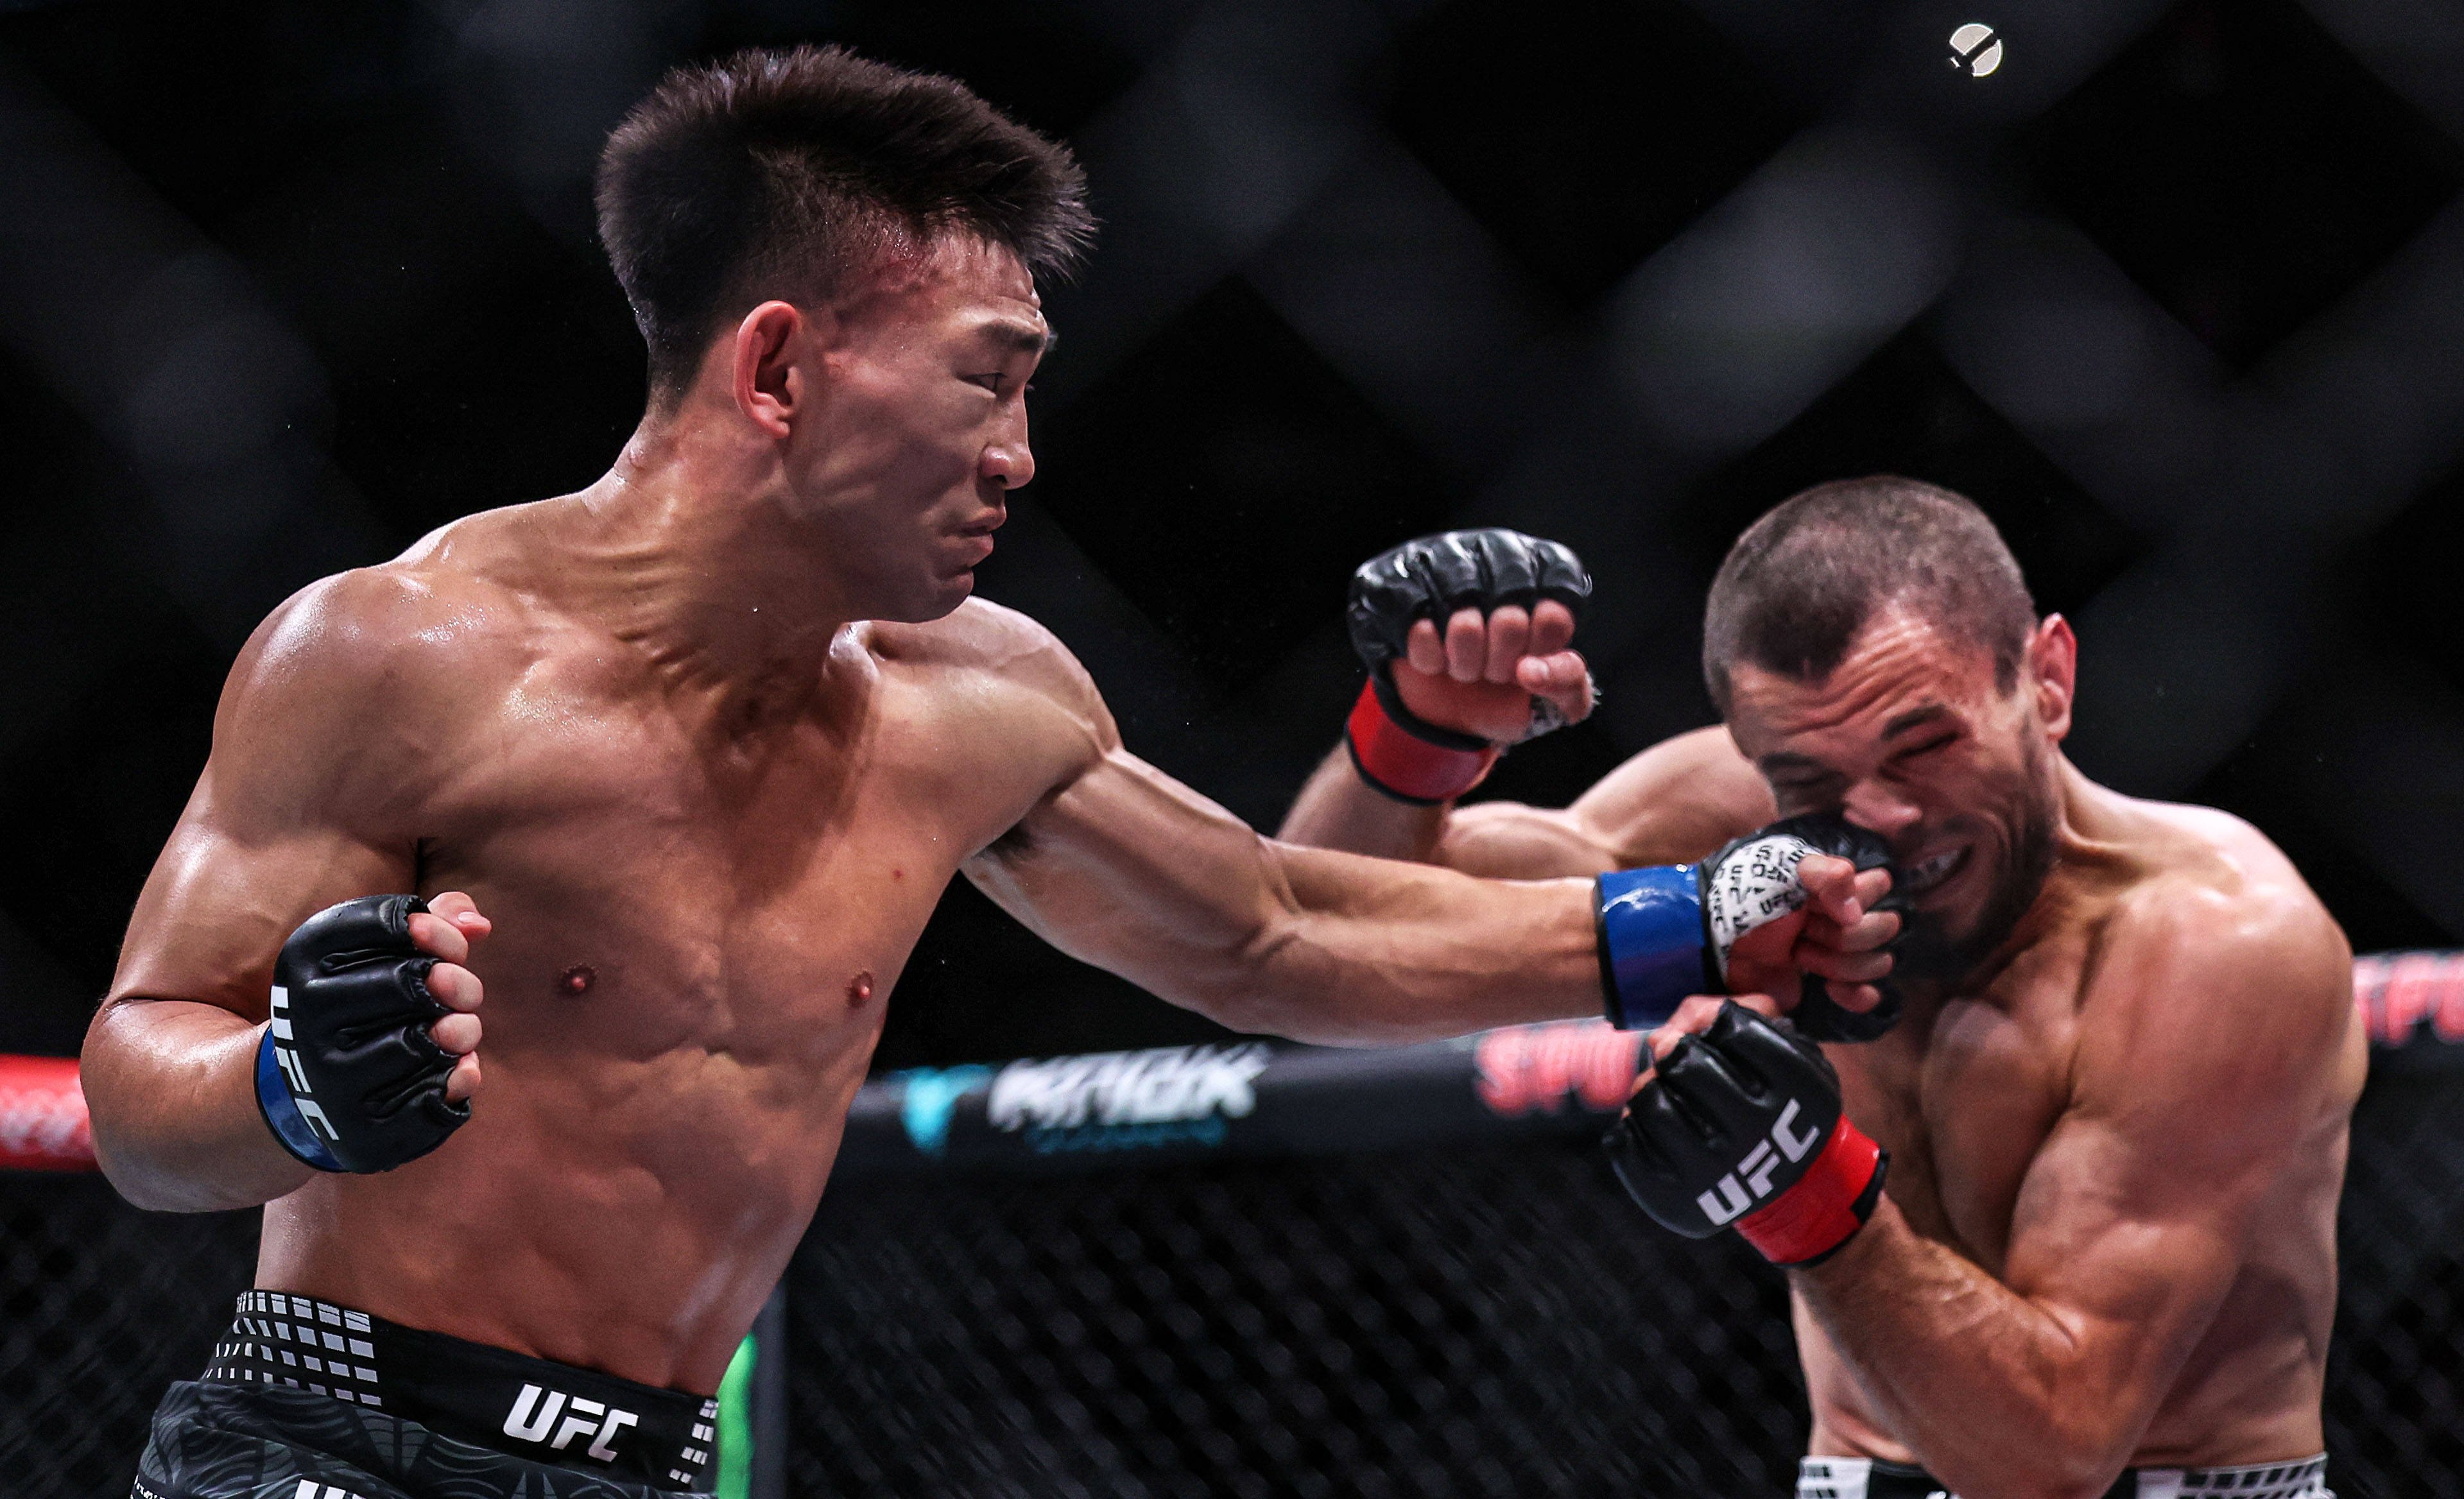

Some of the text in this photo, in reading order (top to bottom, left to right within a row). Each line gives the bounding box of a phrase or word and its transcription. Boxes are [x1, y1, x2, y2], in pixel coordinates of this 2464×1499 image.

[270, 985, 340, 1141] UFC
[1697, 1098, 1820, 1226] UFC
[503, 1384, 639, 1462] UFC
